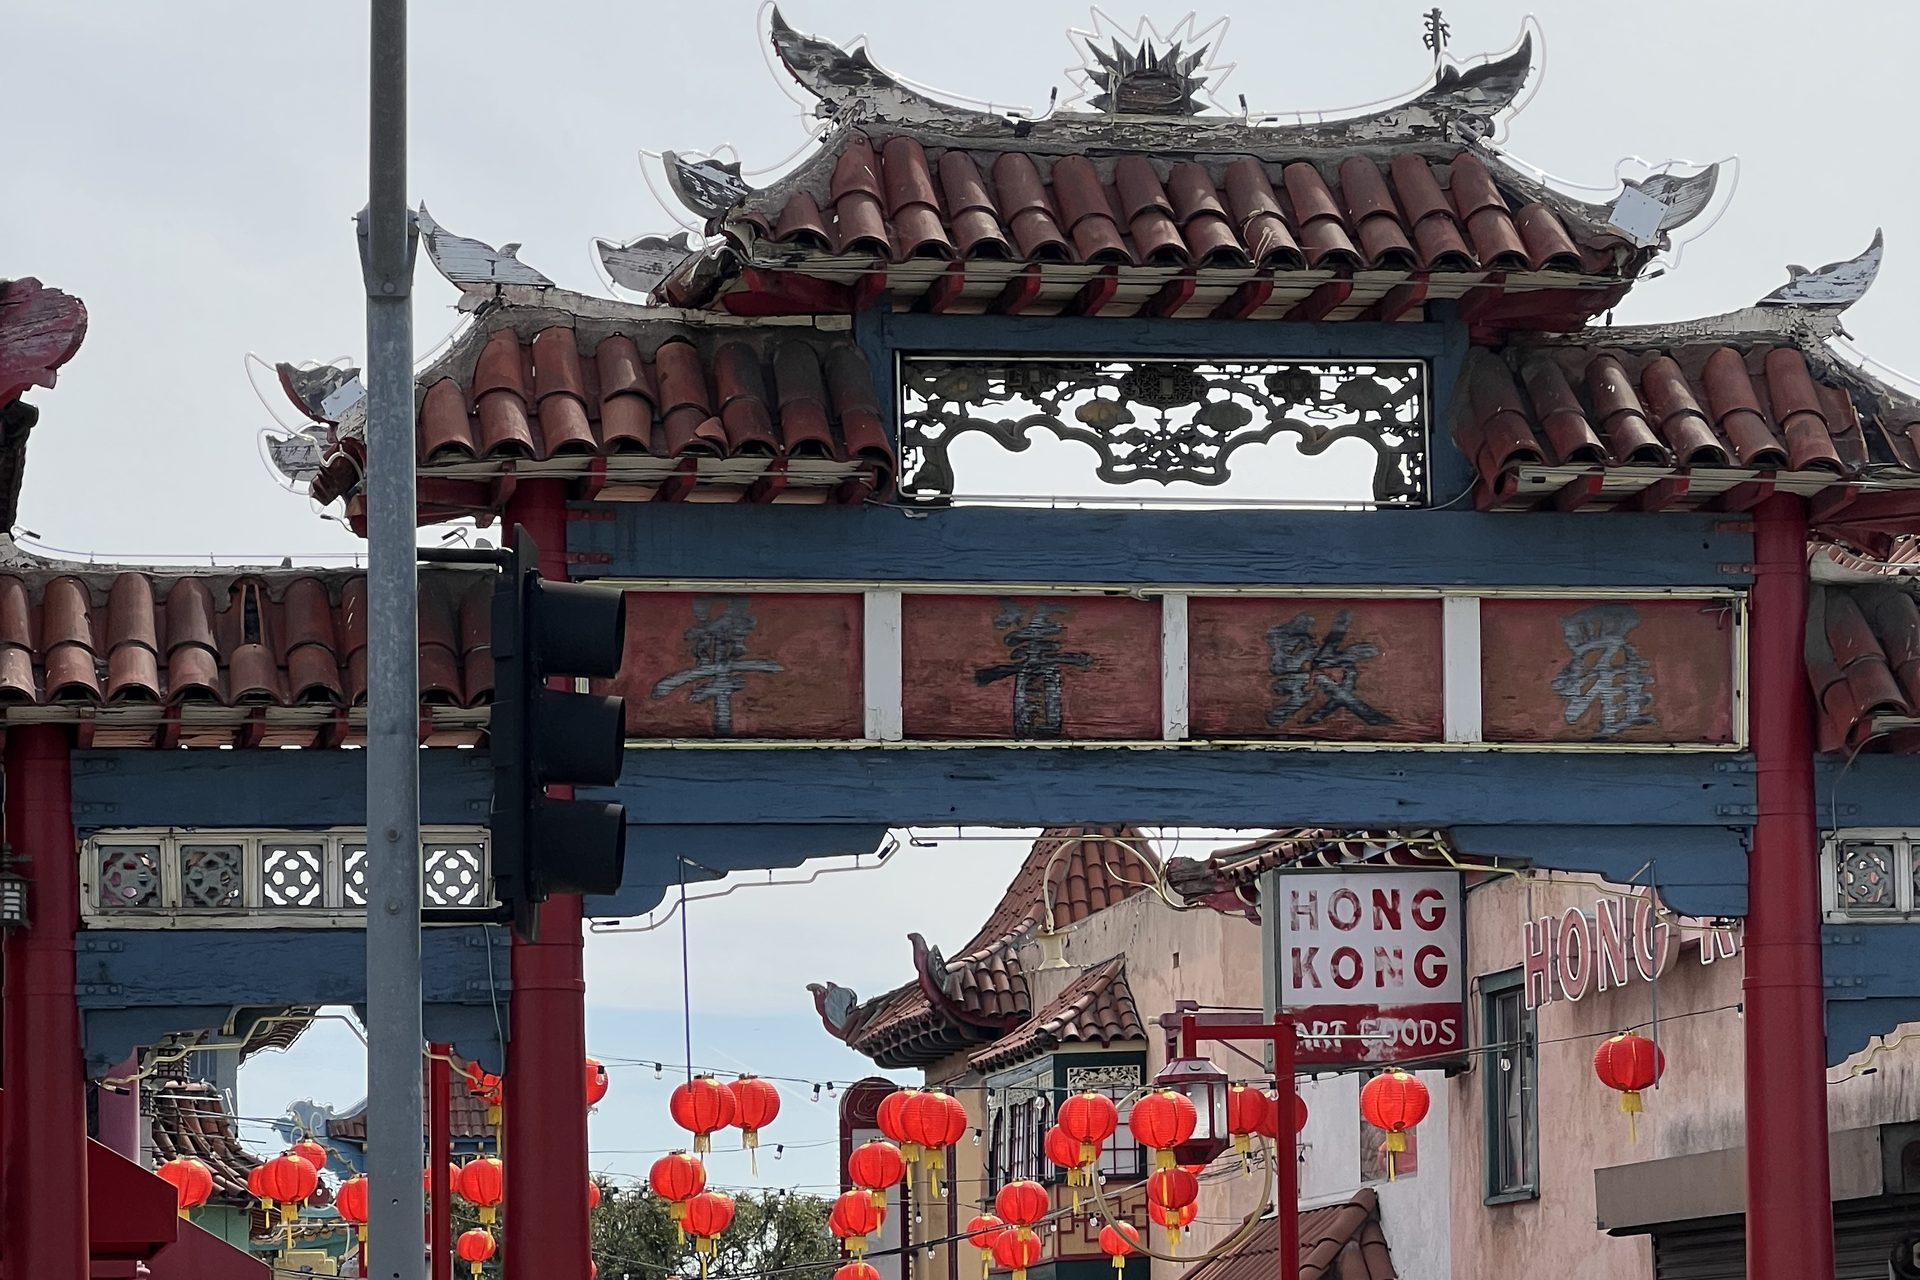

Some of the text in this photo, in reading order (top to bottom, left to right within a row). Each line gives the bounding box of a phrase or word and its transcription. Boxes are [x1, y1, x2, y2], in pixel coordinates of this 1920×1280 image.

[1290, 887, 1447, 932] HONG
[1291, 944, 1449, 990] KONG
[1523, 886, 1670, 1011] HONG
[1295, 1017, 1457, 1050] ART GOODS
